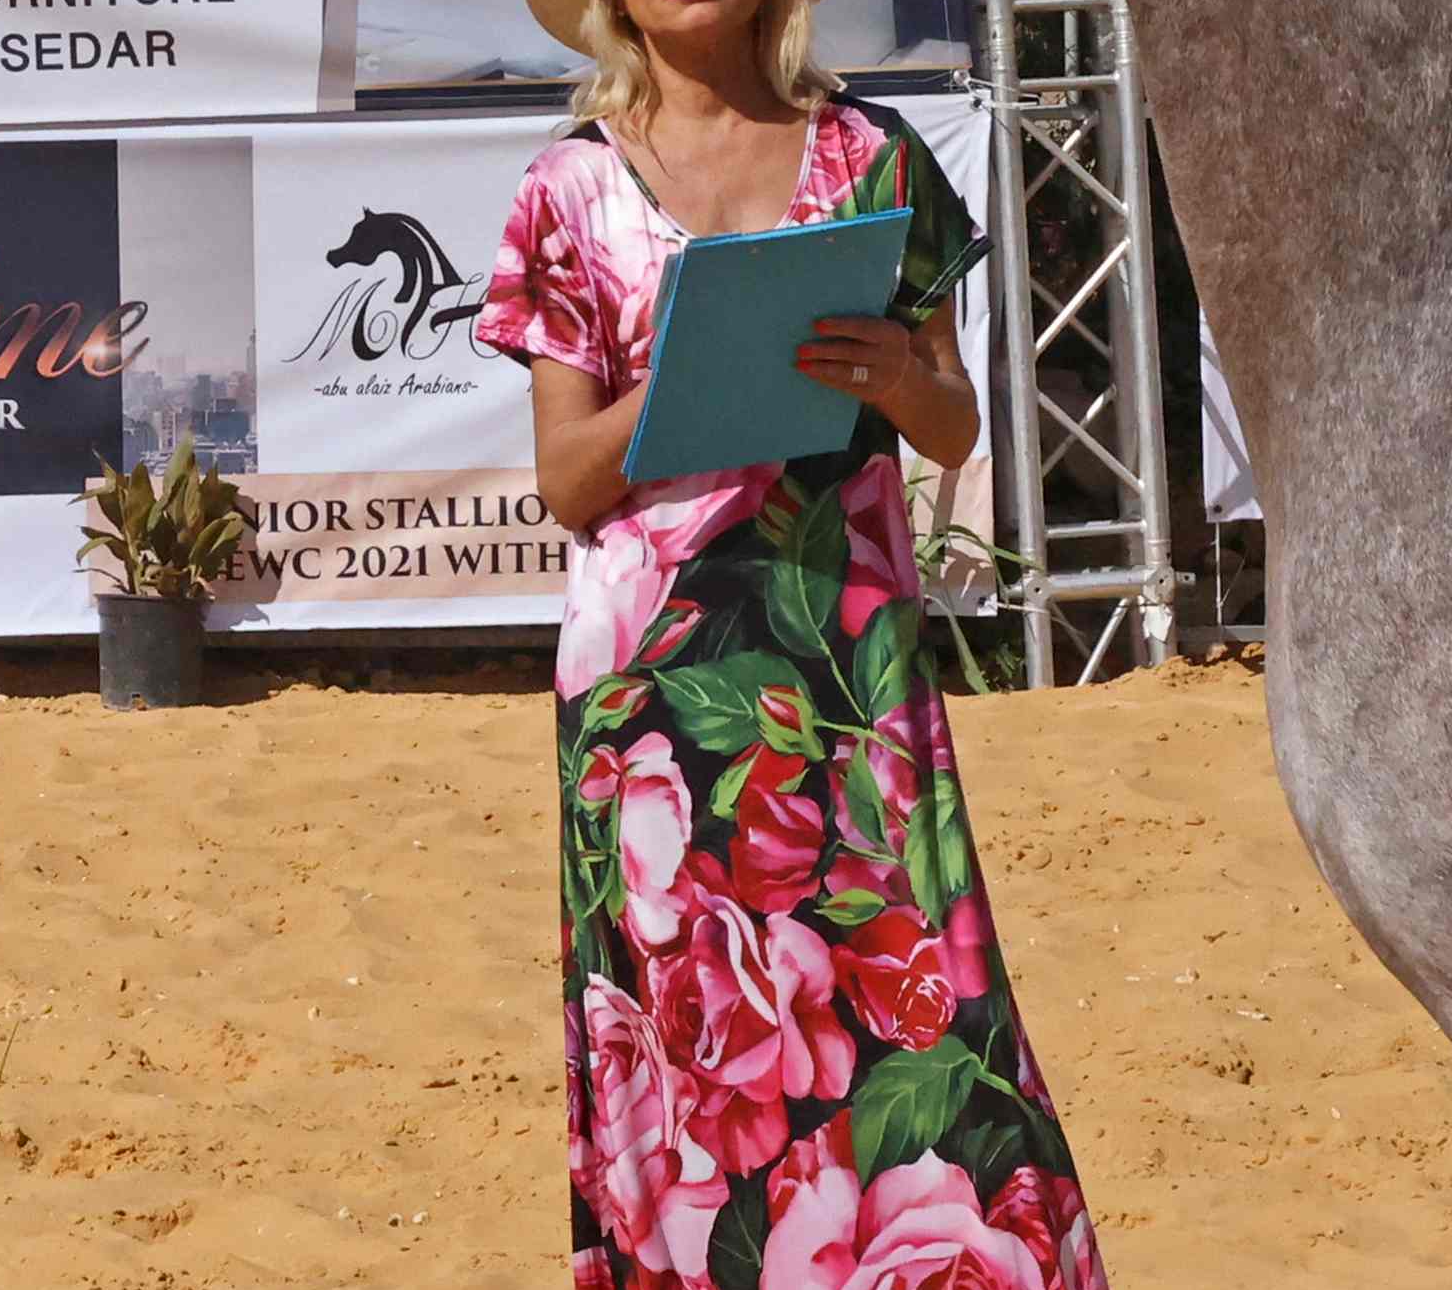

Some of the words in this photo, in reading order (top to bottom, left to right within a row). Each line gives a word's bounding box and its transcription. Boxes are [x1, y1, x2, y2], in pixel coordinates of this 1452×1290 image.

[0, 30, 176, 73] SEDAR
[356, 374, 391, 395] alaiz
[365, 494, 561, 530] STALLIO
[336, 545, 428, 579] 2021
[443, 541, 569, 575] WITH
